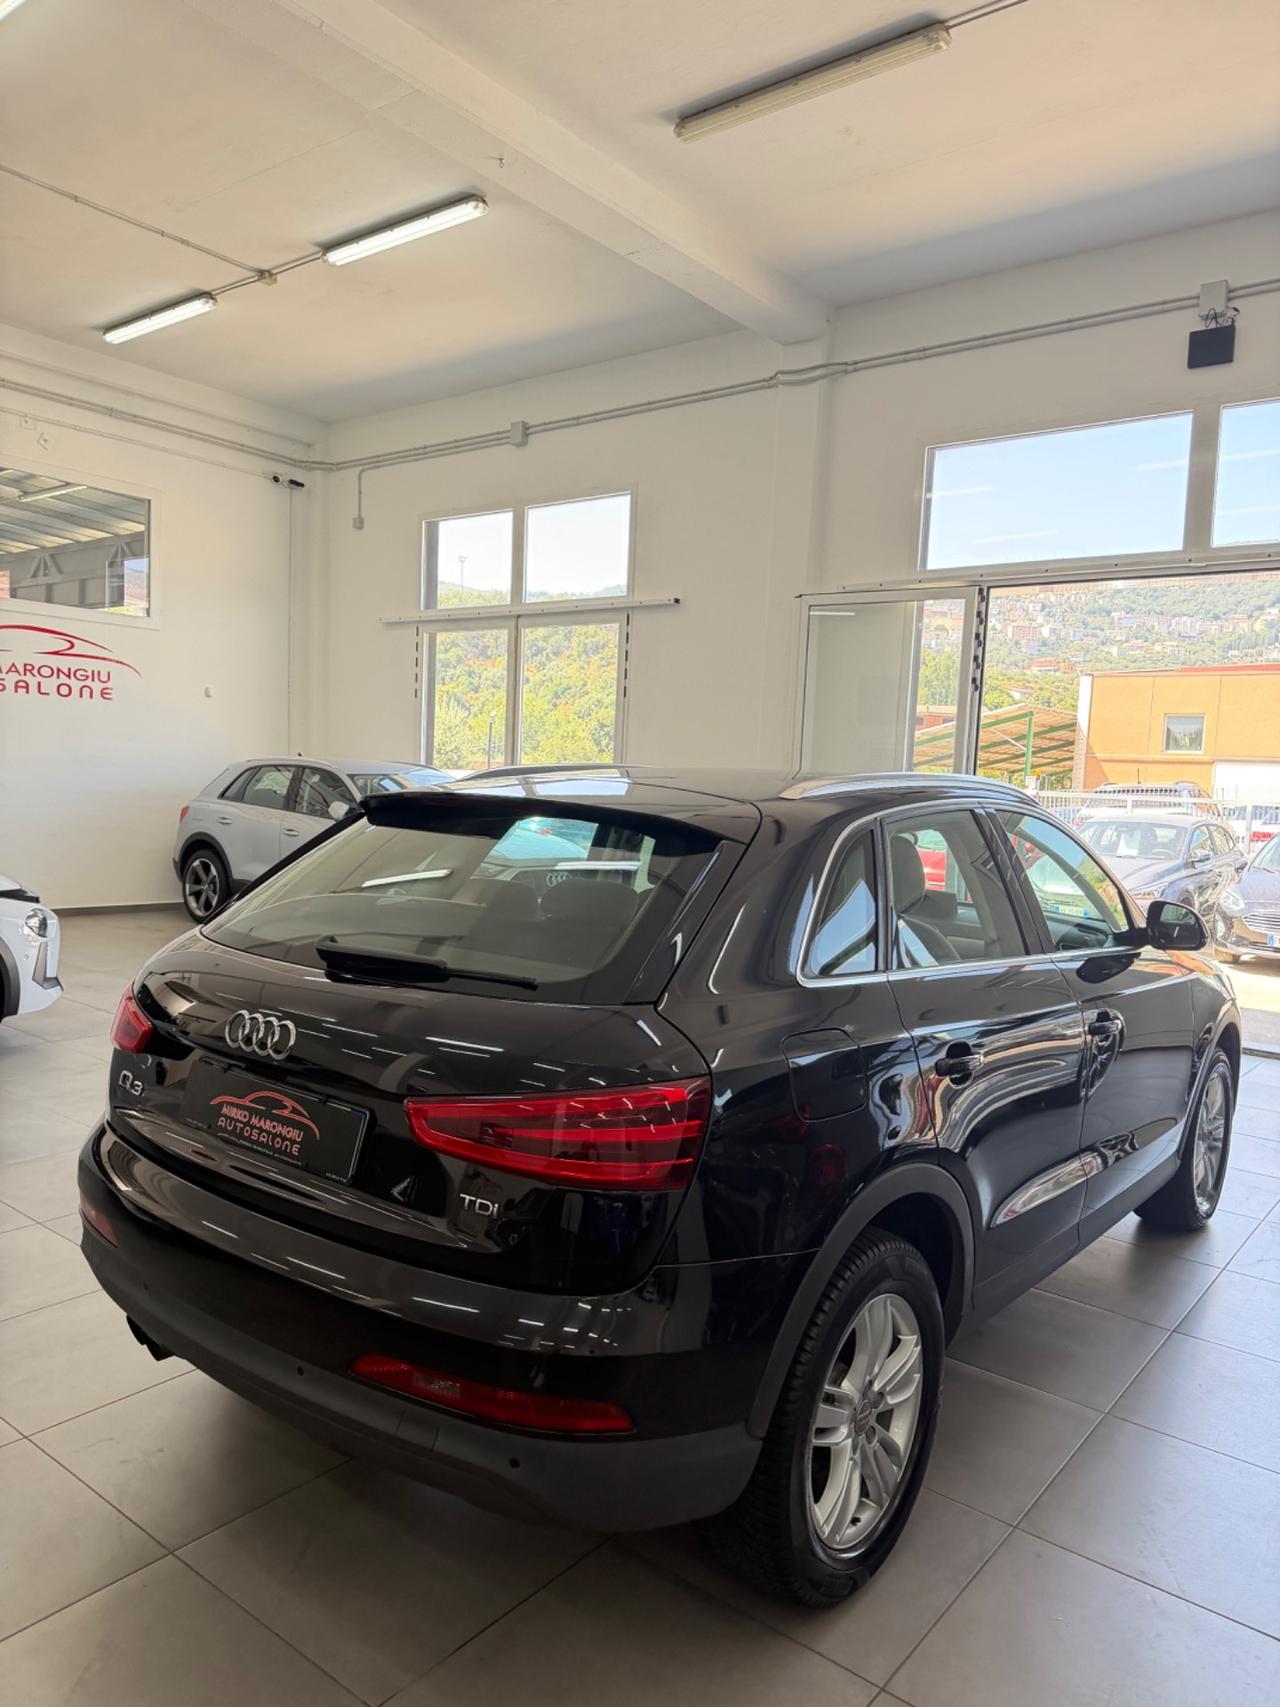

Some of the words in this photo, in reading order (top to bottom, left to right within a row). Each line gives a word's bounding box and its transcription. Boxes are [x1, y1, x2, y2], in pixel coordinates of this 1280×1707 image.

[0, 662, 111, 684] ARONGIU
[119, 1070, 143, 1096] Q3
[217, 1117, 301, 1156] AUTOSALONE
[250, 1114, 304, 1142] MARONGIU
